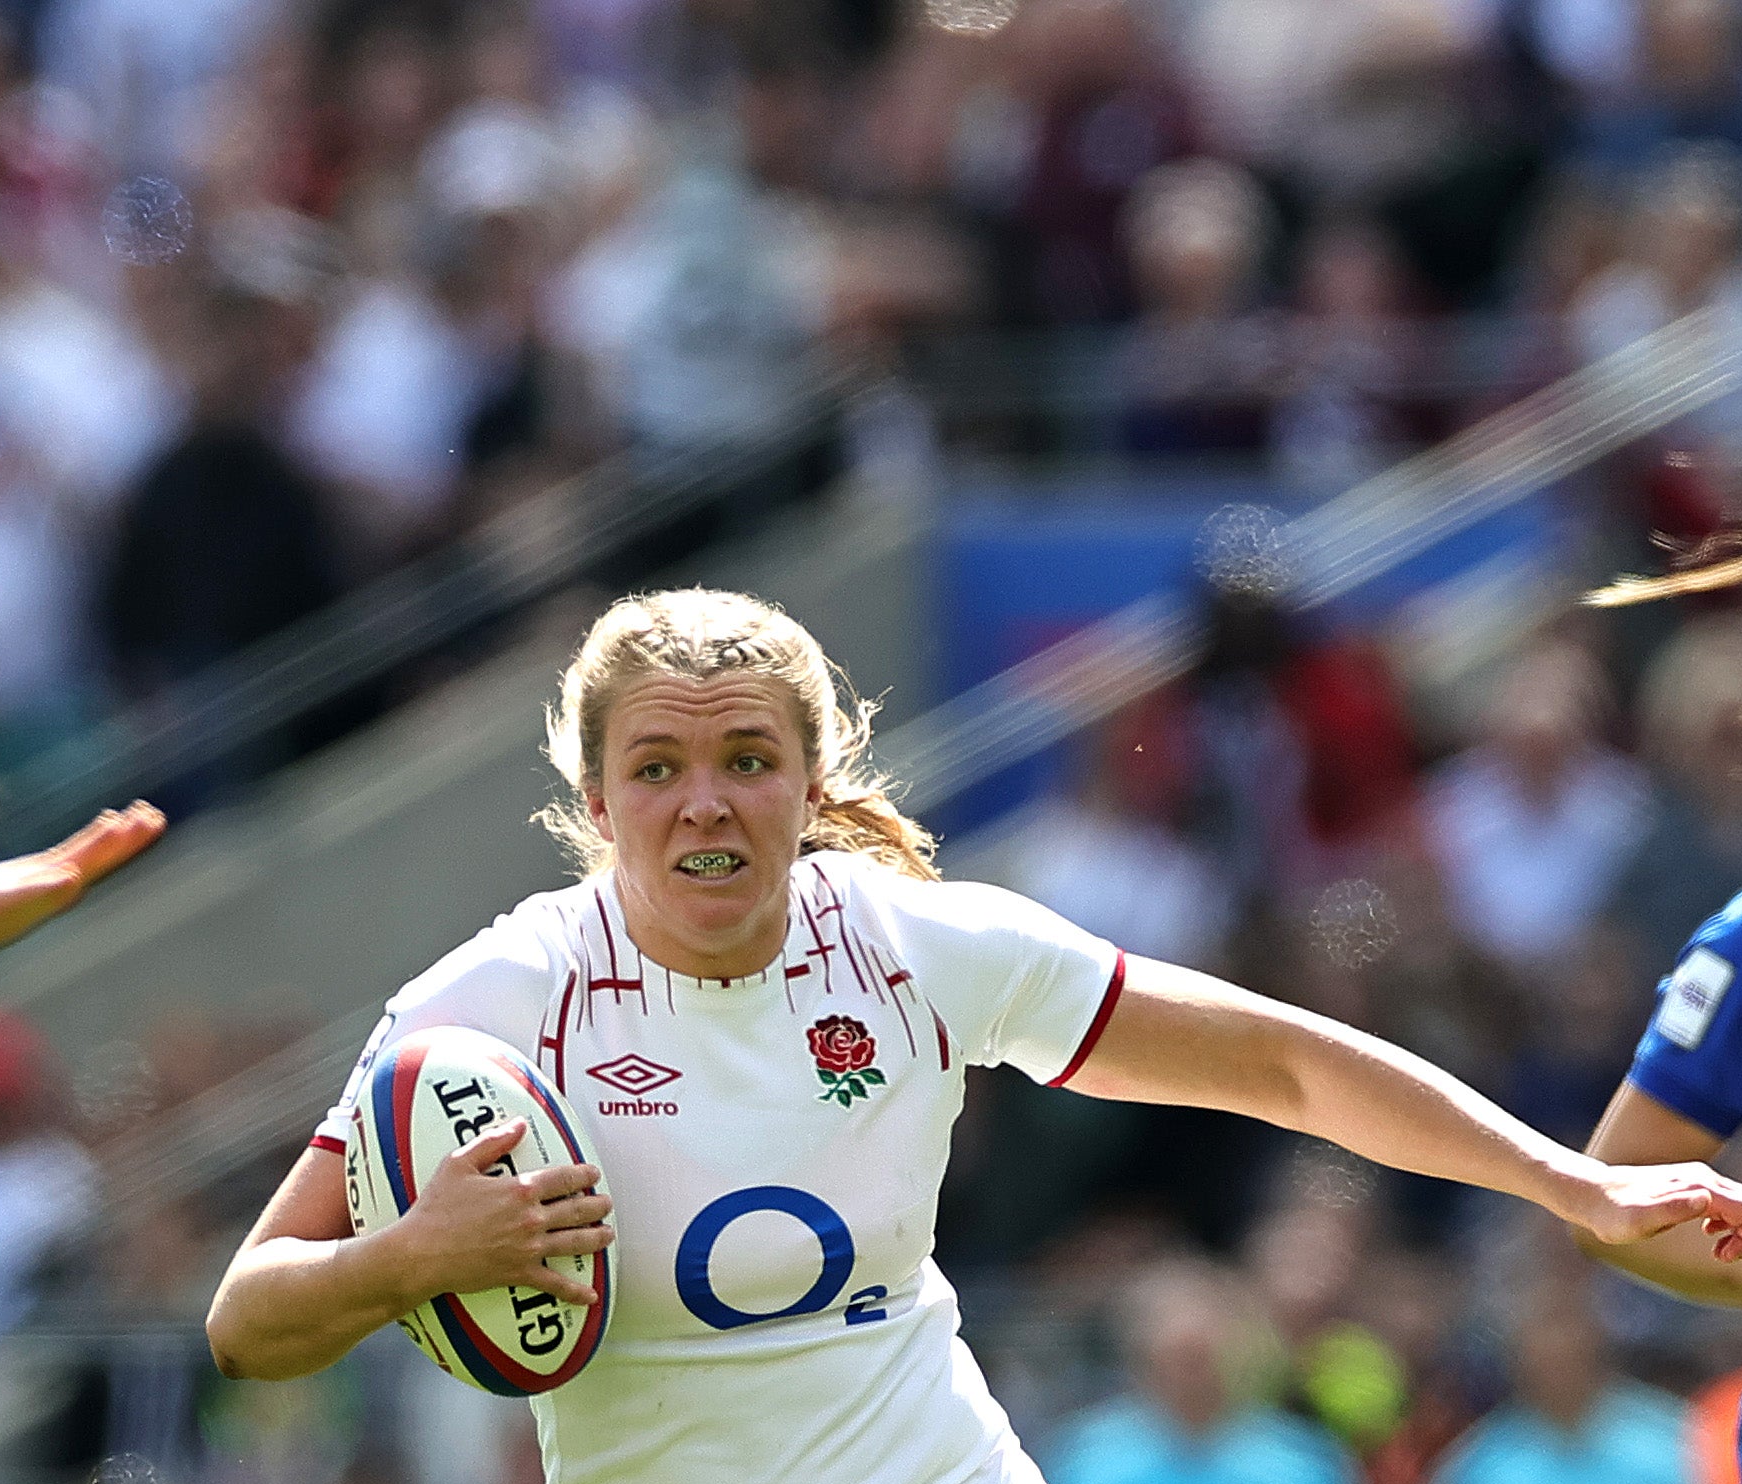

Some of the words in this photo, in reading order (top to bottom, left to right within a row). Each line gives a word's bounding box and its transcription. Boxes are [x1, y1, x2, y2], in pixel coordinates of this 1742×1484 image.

[598, 1098, 679, 1117] umbro
[432, 1076, 566, 1357] GIRT
[674, 1185, 889, 1332] O2
